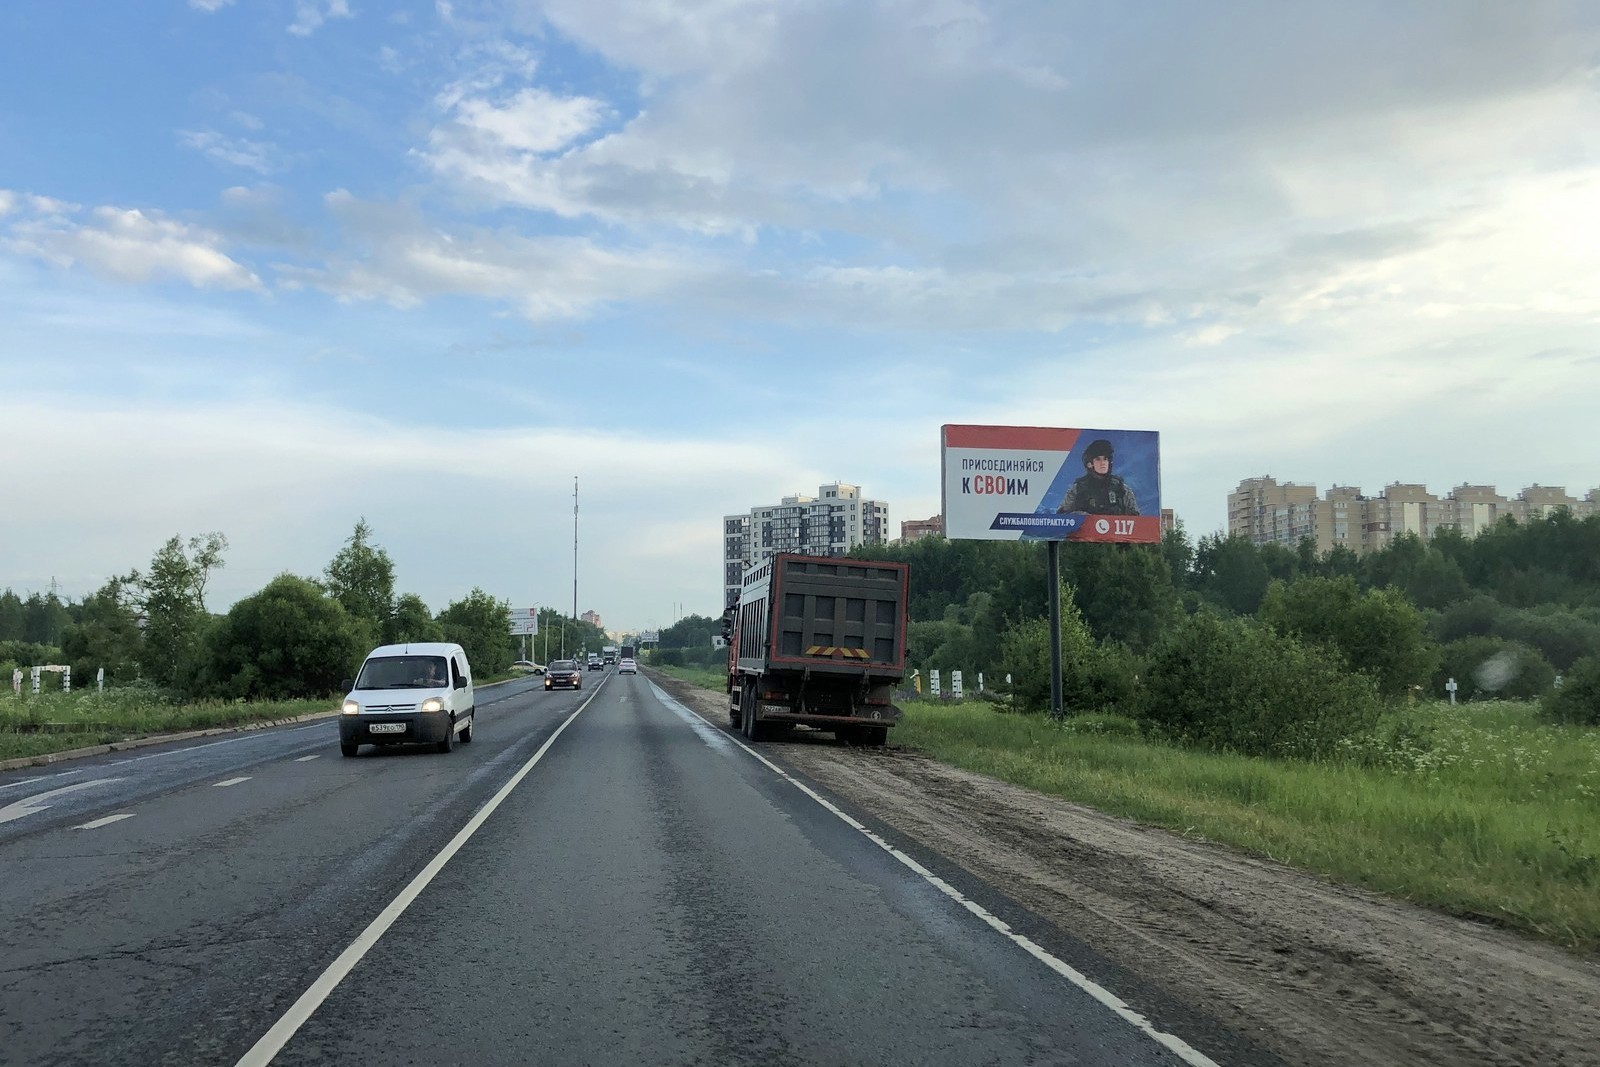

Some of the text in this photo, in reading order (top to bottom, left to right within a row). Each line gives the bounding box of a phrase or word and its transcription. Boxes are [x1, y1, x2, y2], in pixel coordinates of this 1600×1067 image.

[962, 458, 1044, 472] ПРИСОЕДИНЯЙСЯ
[962, 474, 1029, 496] К СВОИМ
[999, 516, 1076, 527] СЛУЖБАПОКОНТРАКТУ.РФ
[1114, 519, 1135, 535] 117
